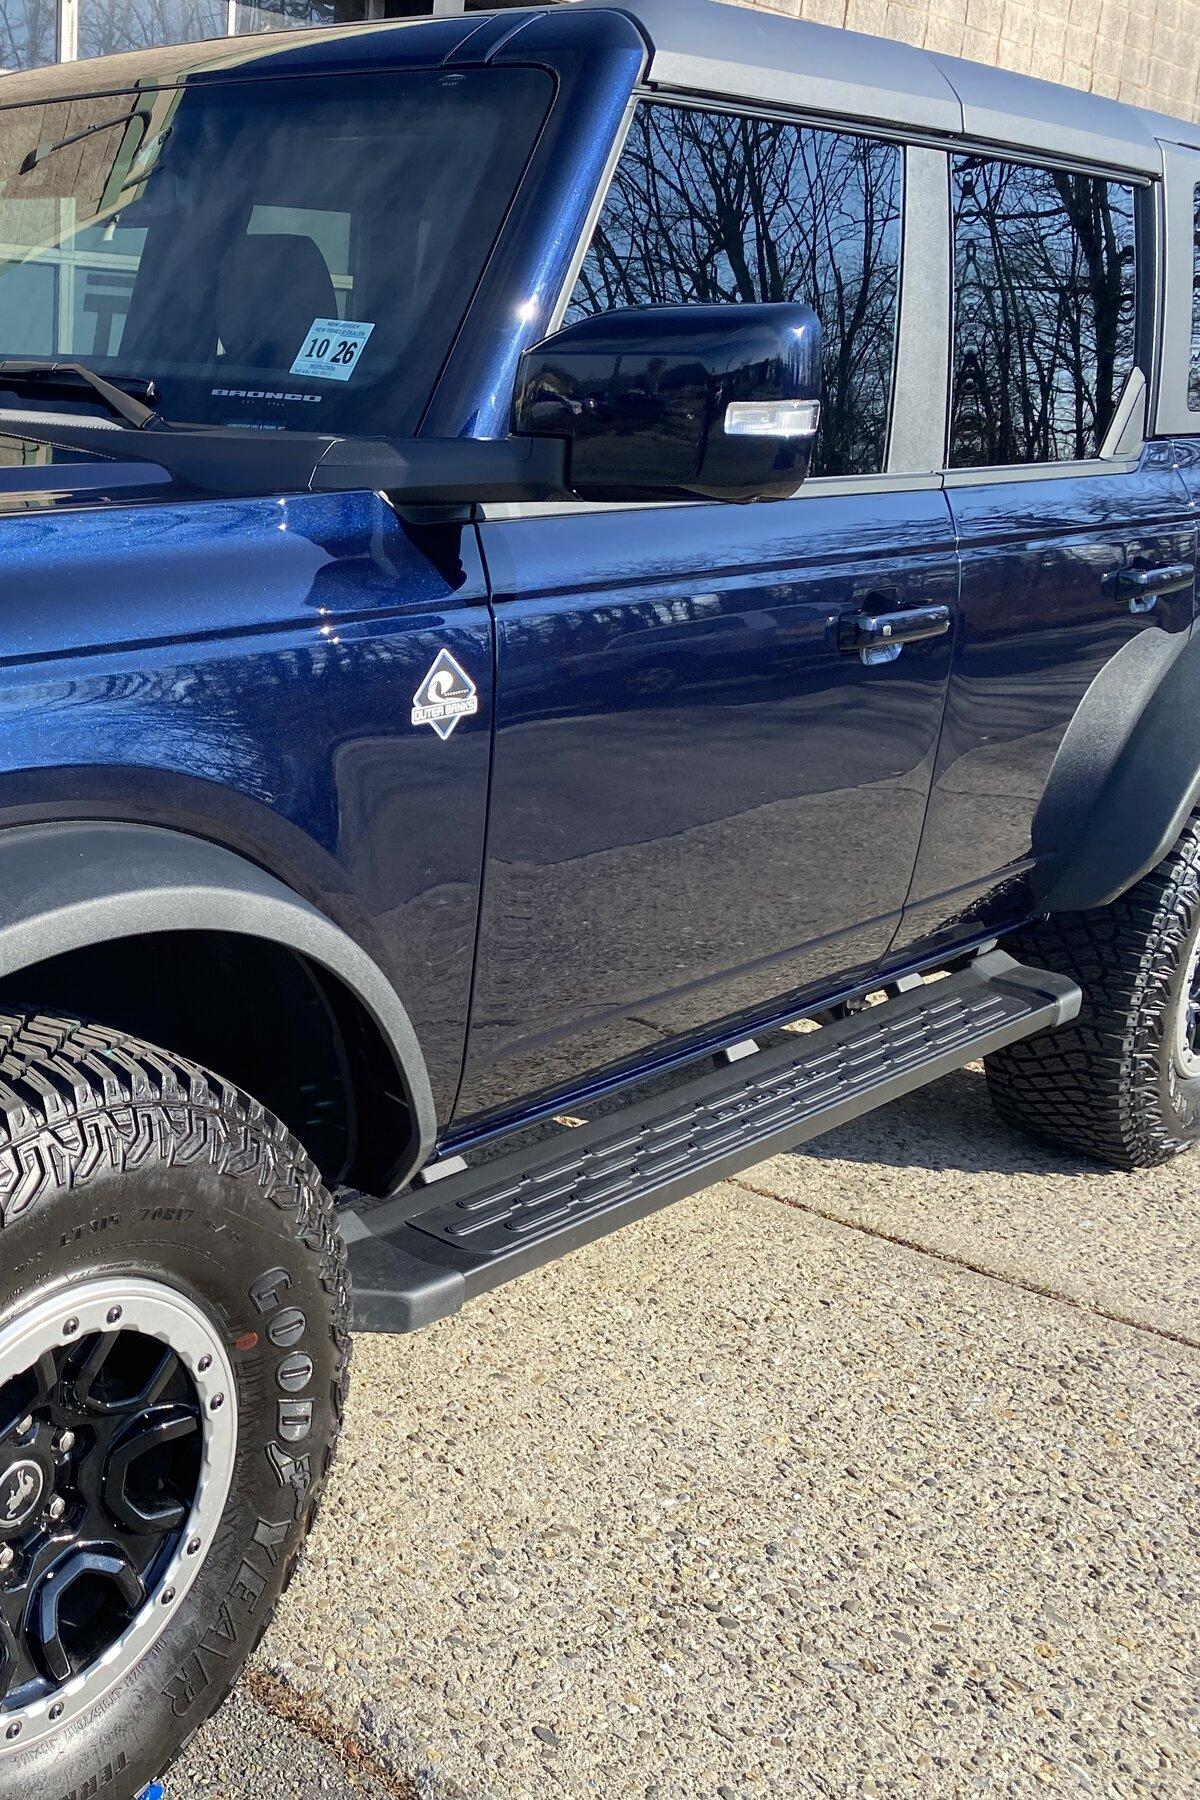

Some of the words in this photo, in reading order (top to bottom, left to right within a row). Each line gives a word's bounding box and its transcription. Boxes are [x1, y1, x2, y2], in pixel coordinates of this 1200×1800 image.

[304, 338, 330, 358] 10
[330, 340, 358, 364] 26
[211, 388, 322, 403] BRONCO
[414, 704, 444, 722] OUTER
[444, 699, 476, 716] BANKS
